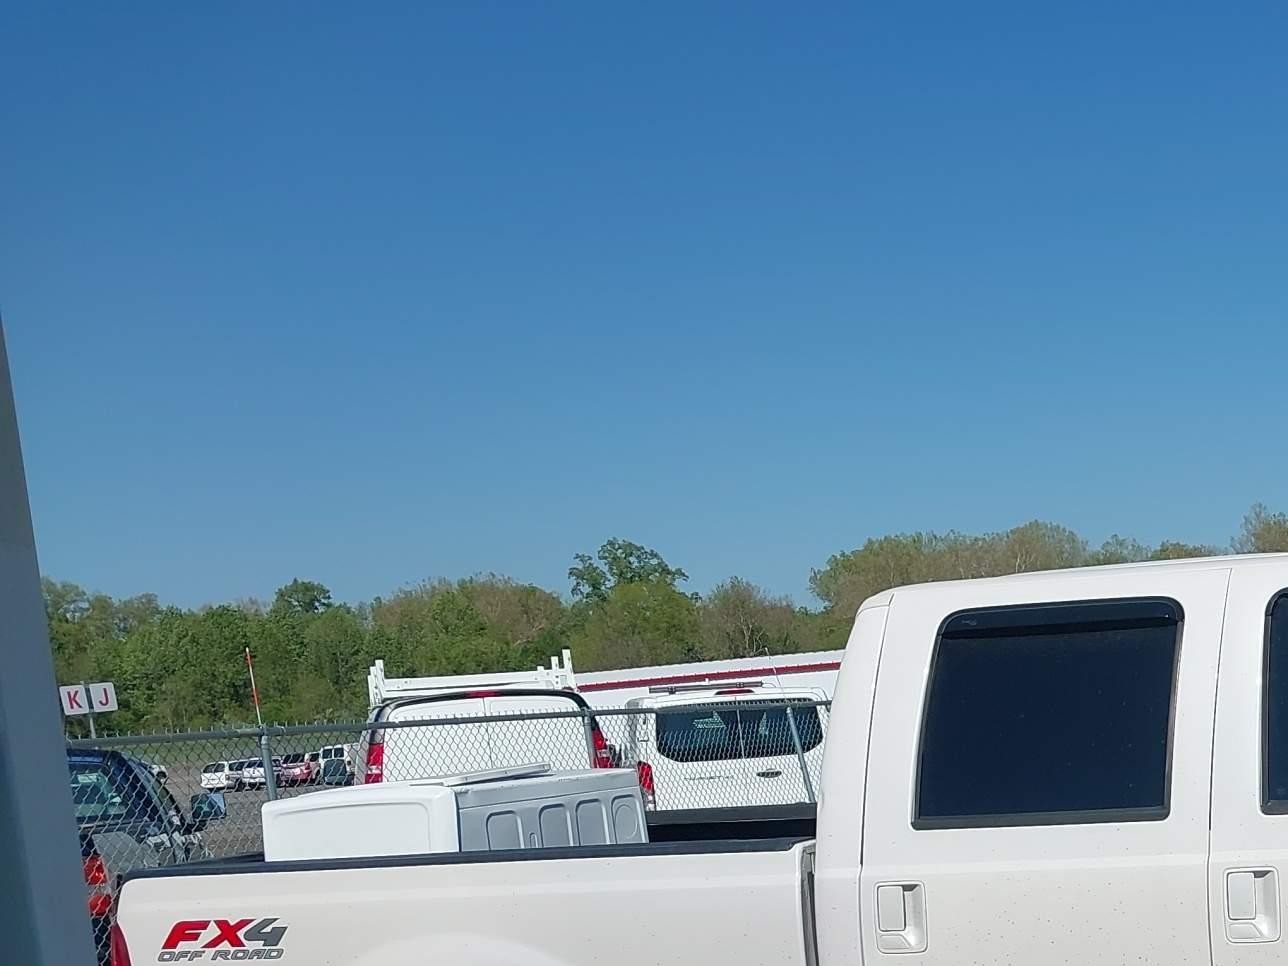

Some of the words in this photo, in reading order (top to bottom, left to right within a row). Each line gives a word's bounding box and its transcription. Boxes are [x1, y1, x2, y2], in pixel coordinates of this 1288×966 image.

[67, 690, 82, 709] K
[99, 688, 109, 706] J
[162, 918, 288, 950] FX4
[158, 950, 206, 962] OFF
[211, 948, 284, 961] ROAD
